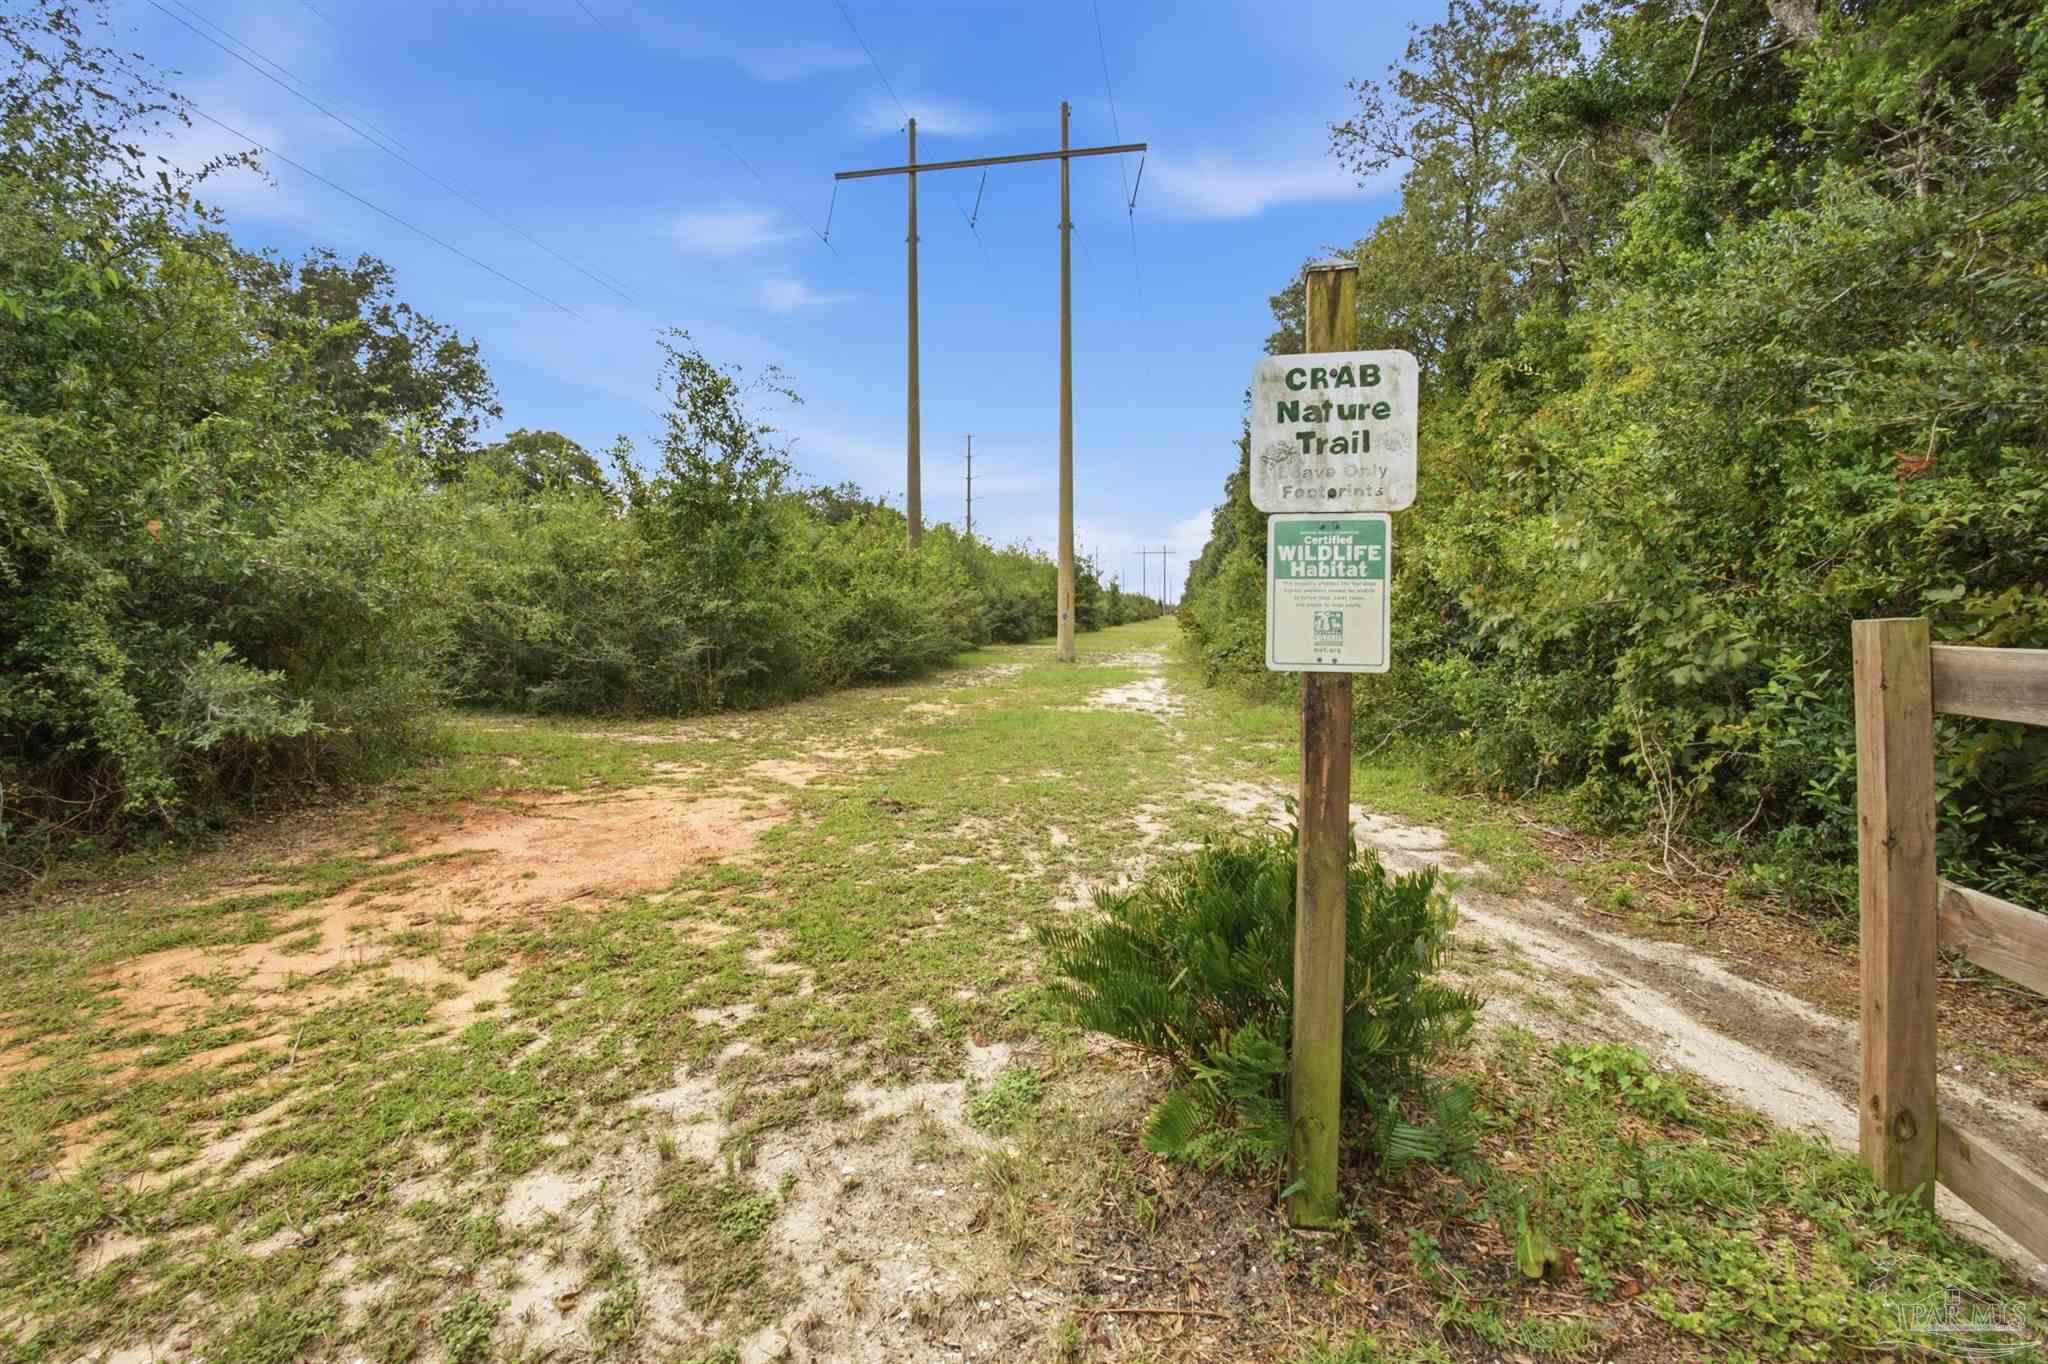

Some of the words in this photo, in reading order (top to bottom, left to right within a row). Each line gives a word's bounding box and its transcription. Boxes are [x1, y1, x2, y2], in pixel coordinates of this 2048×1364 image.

[1285, 364, 1381, 391] CRAB
[1277, 400, 1391, 423] Nature
[1296, 429, 1371, 455] Trail
[1304, 535, 1353, 545] Certified
[1277, 545, 1382, 561] WILDLIFE
[1290, 561, 1369, 577] Habitat
